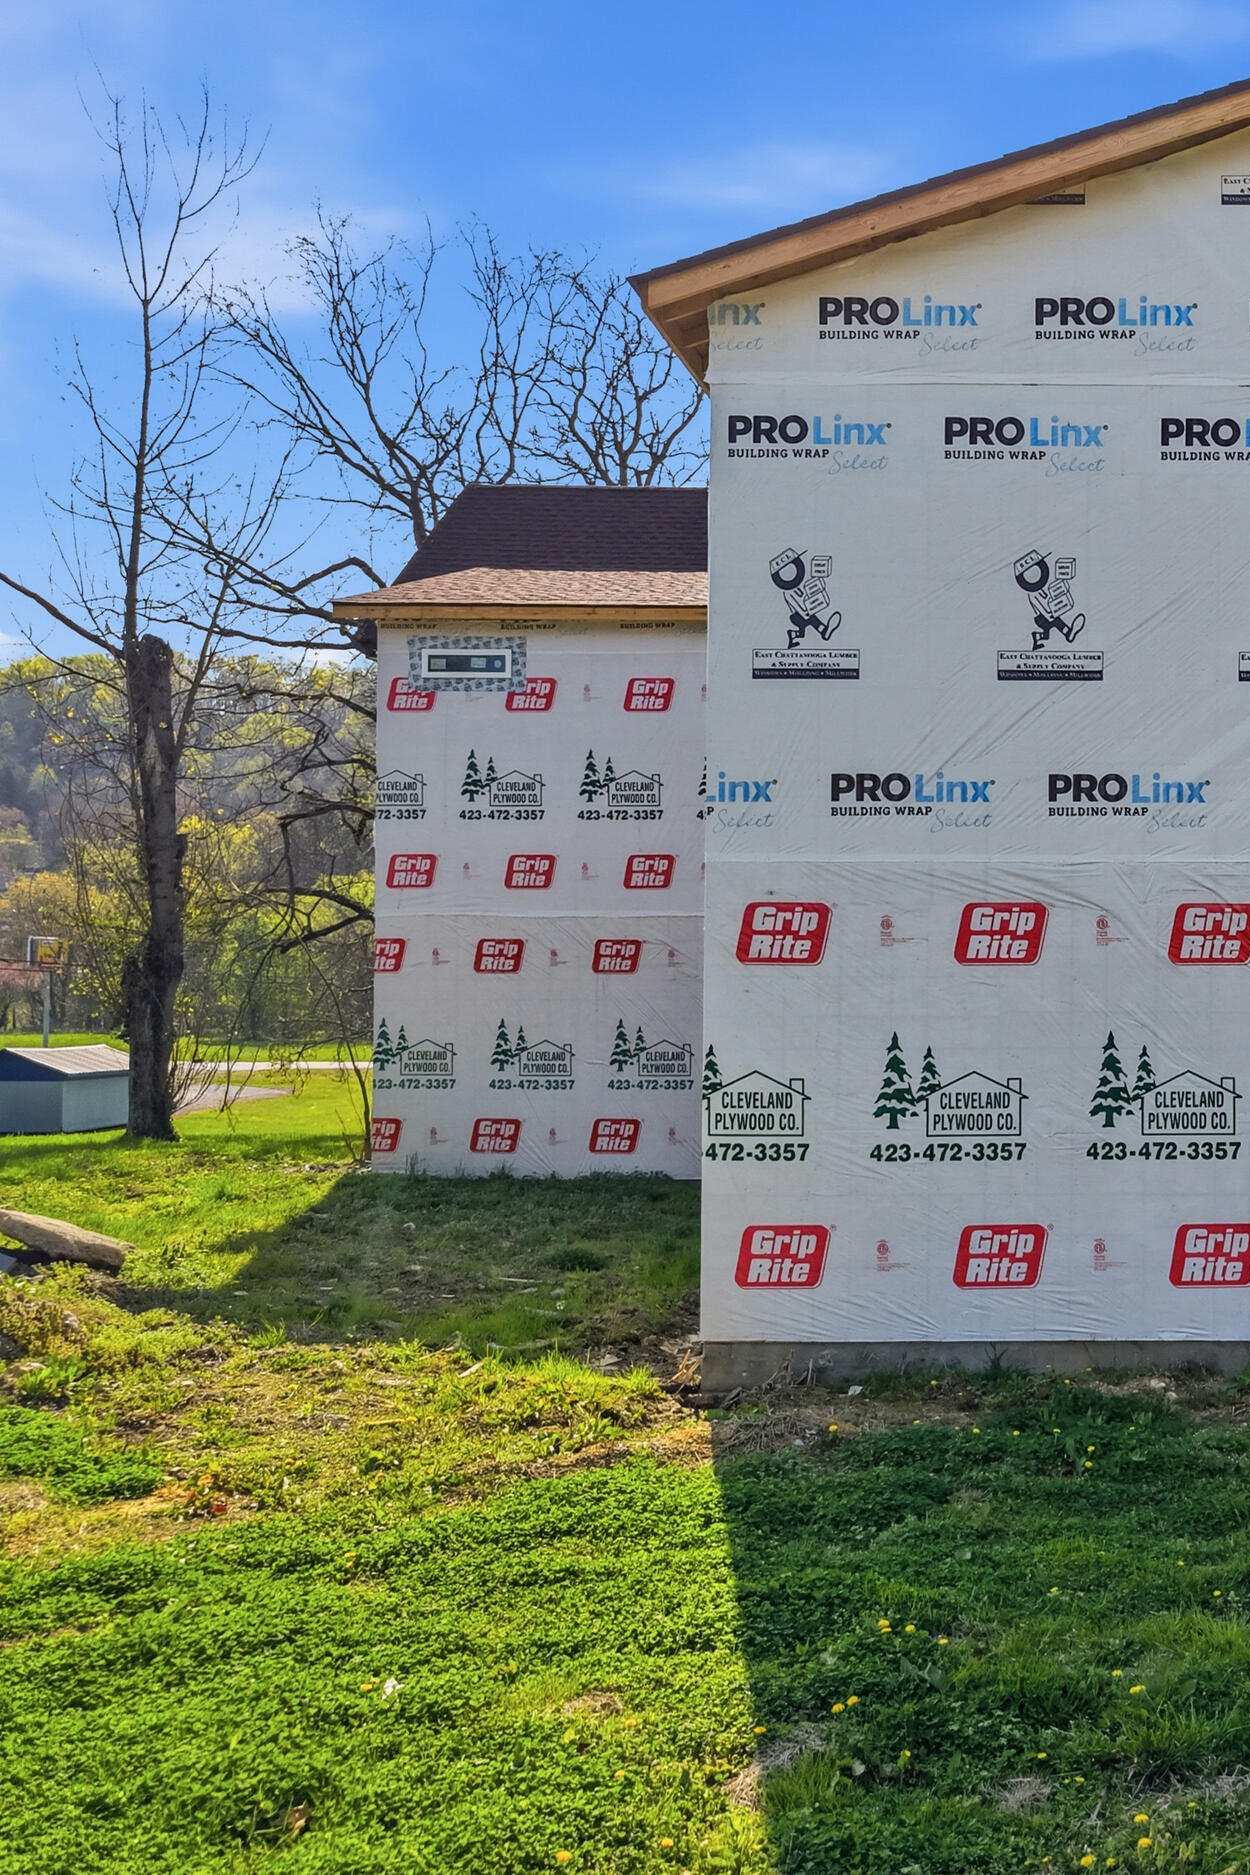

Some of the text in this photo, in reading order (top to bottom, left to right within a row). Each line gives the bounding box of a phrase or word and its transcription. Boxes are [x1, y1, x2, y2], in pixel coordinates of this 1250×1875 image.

[819, 330, 920, 341] BUILDING WRAP
[1035, 330, 1136, 341] BUILDING WRAP
[728, 448, 830, 459] BUILDING WRAP
[945, 448, 1046, 460] BUILDING WRAP
[1161, 450, 1220, 460] BUILDING
[630, 680, 668, 696] Grip
[394, 695, 428, 709] Rite
[512, 695, 546, 709] Rite
[630, 695, 664, 709] Rite
[498, 781, 537, 791] CLEVELAND
[616, 781, 655, 791] CLEVELAND
[494, 793, 527, 803] PLYWOOD
[612, 793, 645, 803] PLYWOOD
[459, 810, 545, 820] 423-472-3357
[577, 810, 663, 820] 423-472-3357
[831, 804, 932, 816] BUILDING WRAP
[1048, 806, 1150, 817] BUILDING WRAP
[394, 856, 430, 872] Grip
[630, 858, 668, 874] Grip
[392, 872, 427, 886] Rite
[630, 873, 664, 887] Rite
[751, 906, 816, 936] Grip
[970, 906, 1035, 936] Grip
[1183, 907, 1248, 936] Grip
[480, 942, 516, 958] Grip
[748, 934, 809, 960] Rite
[967, 934, 1028, 960] Rite
[1180, 935, 1241, 960] Rite
[478, 957, 513, 971] Rite
[528, 1051, 567, 1061] CLEVELAND
[647, 1051, 686, 1061] CLEVELAND
[524, 1062, 557, 1073] PLYWOOD
[643, 1063, 676, 1073] PLYWOOD
[489, 1080, 575, 1090] 423-472-3357
[608, 1080, 694, 1090] 423-472-3357
[722, 1091, 794, 1110] CLEVELAND
[940, 1091, 1010, 1110] CLEVELAND
[1156, 1091, 1226, 1110] CLEVELAND
[715, 1112, 800, 1132] PLYWOOD CO.
[932, 1112, 1016, 1131] PLYWOOD CO.
[1149, 1112, 1231, 1131] PLYWOOD CO.
[476, 1122, 514, 1138] Grip
[596, 1122, 633, 1138] Grip
[476, 1137, 510, 1151] Rite
[595, 1138, 630, 1152] Rite
[870, 1143, 1026, 1162] 423-472-3357
[1086, 1143, 1241, 1161] 423-472-3357
[751, 1230, 816, 1258] Grip
[969, 1229, 1035, 1258] Grip
[1185, 1228, 1250, 1258] Grip
[747, 1258, 809, 1282] Rite
[966, 1257, 1028, 1282] Rite
[1182, 1256, 1244, 1282] Rite
